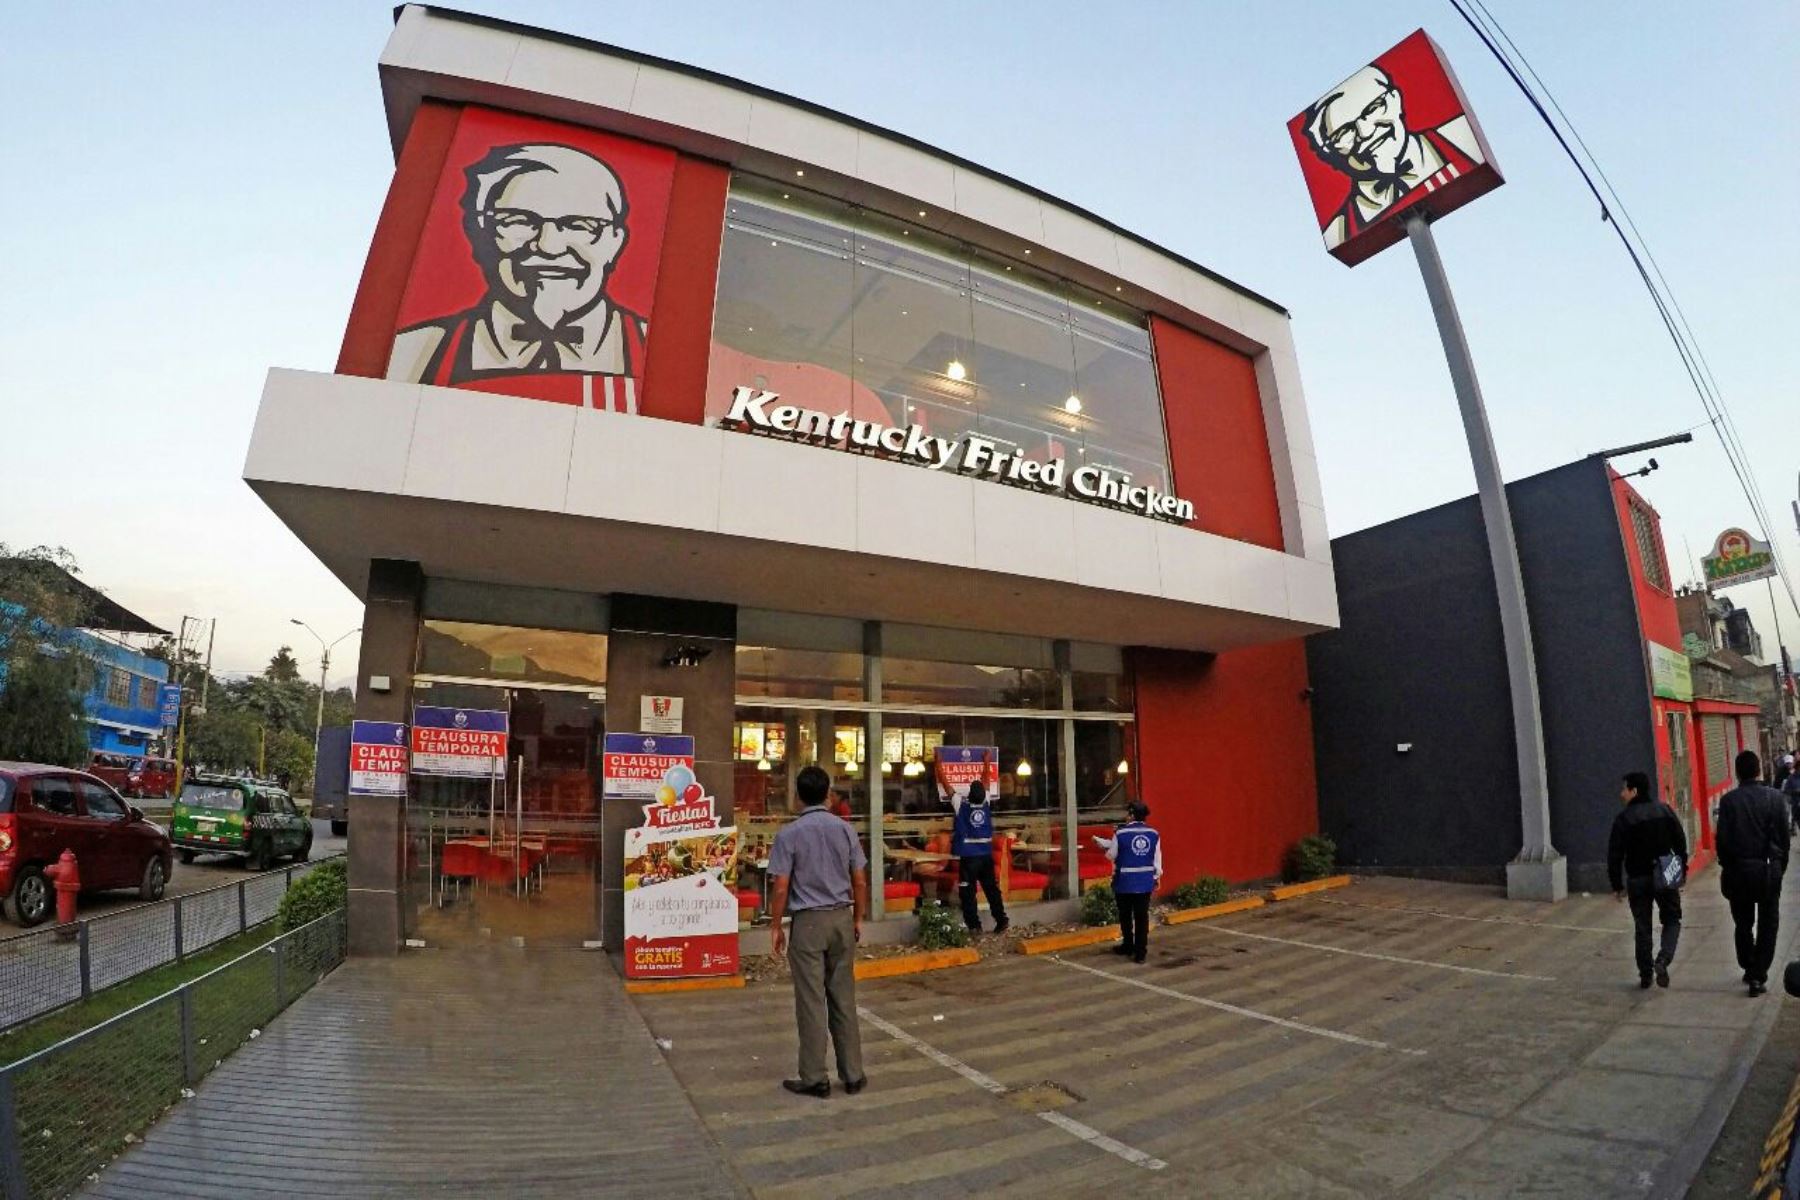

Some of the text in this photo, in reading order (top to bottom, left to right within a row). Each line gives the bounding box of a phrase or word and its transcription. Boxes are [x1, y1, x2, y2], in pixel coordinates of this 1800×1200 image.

[723, 384, 1194, 520] Kentucky Fried Chicken
[420, 730, 500, 745] CLAUSURA
[420, 742, 500, 756] TEMPORAL
[358, 758, 403, 771] TEMP
[611, 755, 687, 767] CLAUSURA
[610, 766, 669, 777] TEMPO
[657, 806, 708, 825] Fiestas
[635, 951, 683, 964] GRATIS
